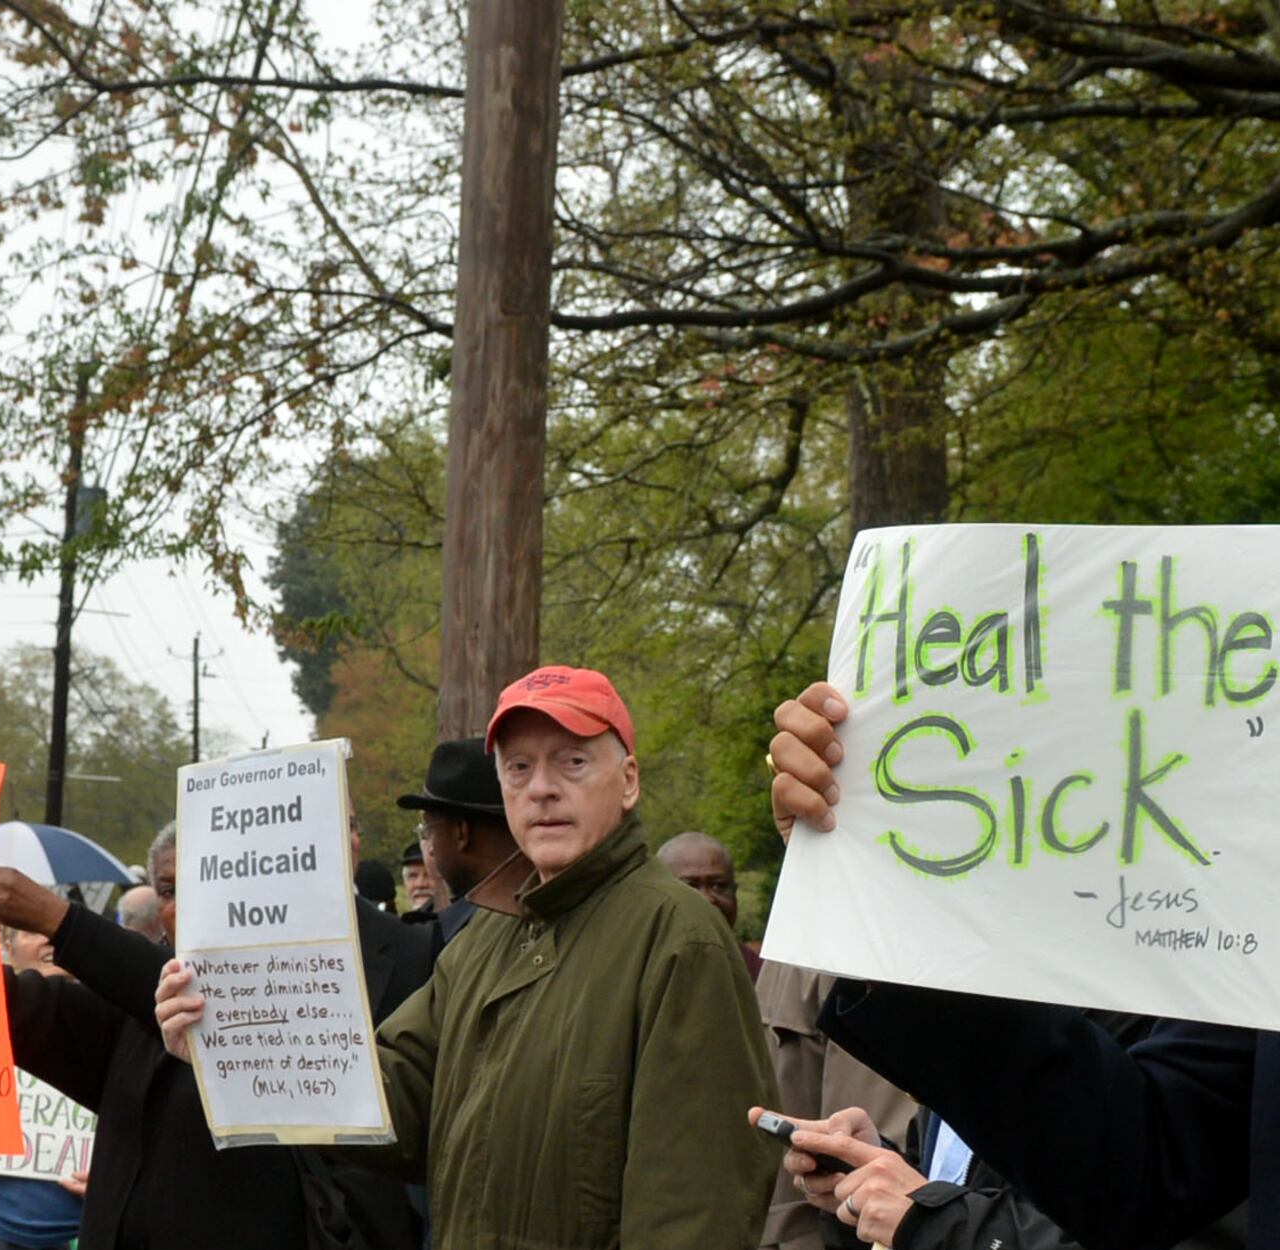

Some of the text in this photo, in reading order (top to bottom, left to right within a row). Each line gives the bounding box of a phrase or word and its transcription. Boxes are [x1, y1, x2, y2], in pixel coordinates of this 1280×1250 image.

[1101, 553, 1280, 708] the
[186, 757, 326, 793] Dear Governor Deal,
[211, 795, 302, 835] Expand
[200, 845, 317, 882] Medicaid
[228, 901, 288, 929] Now
[1135, 926, 1259, 956] MATTHEW 10:8
[266, 953, 345, 976] diminishes
[199, 978, 341, 1002] the poor diminishes
[215, 1005, 289, 1026] everybody
[201, 1027, 365, 1051] We are tied in a single
[215, 1054, 274, 1079] garment
[280, 1054, 293, 1070] of
[252, 1075, 337, 1099] (MLK, 1967)
